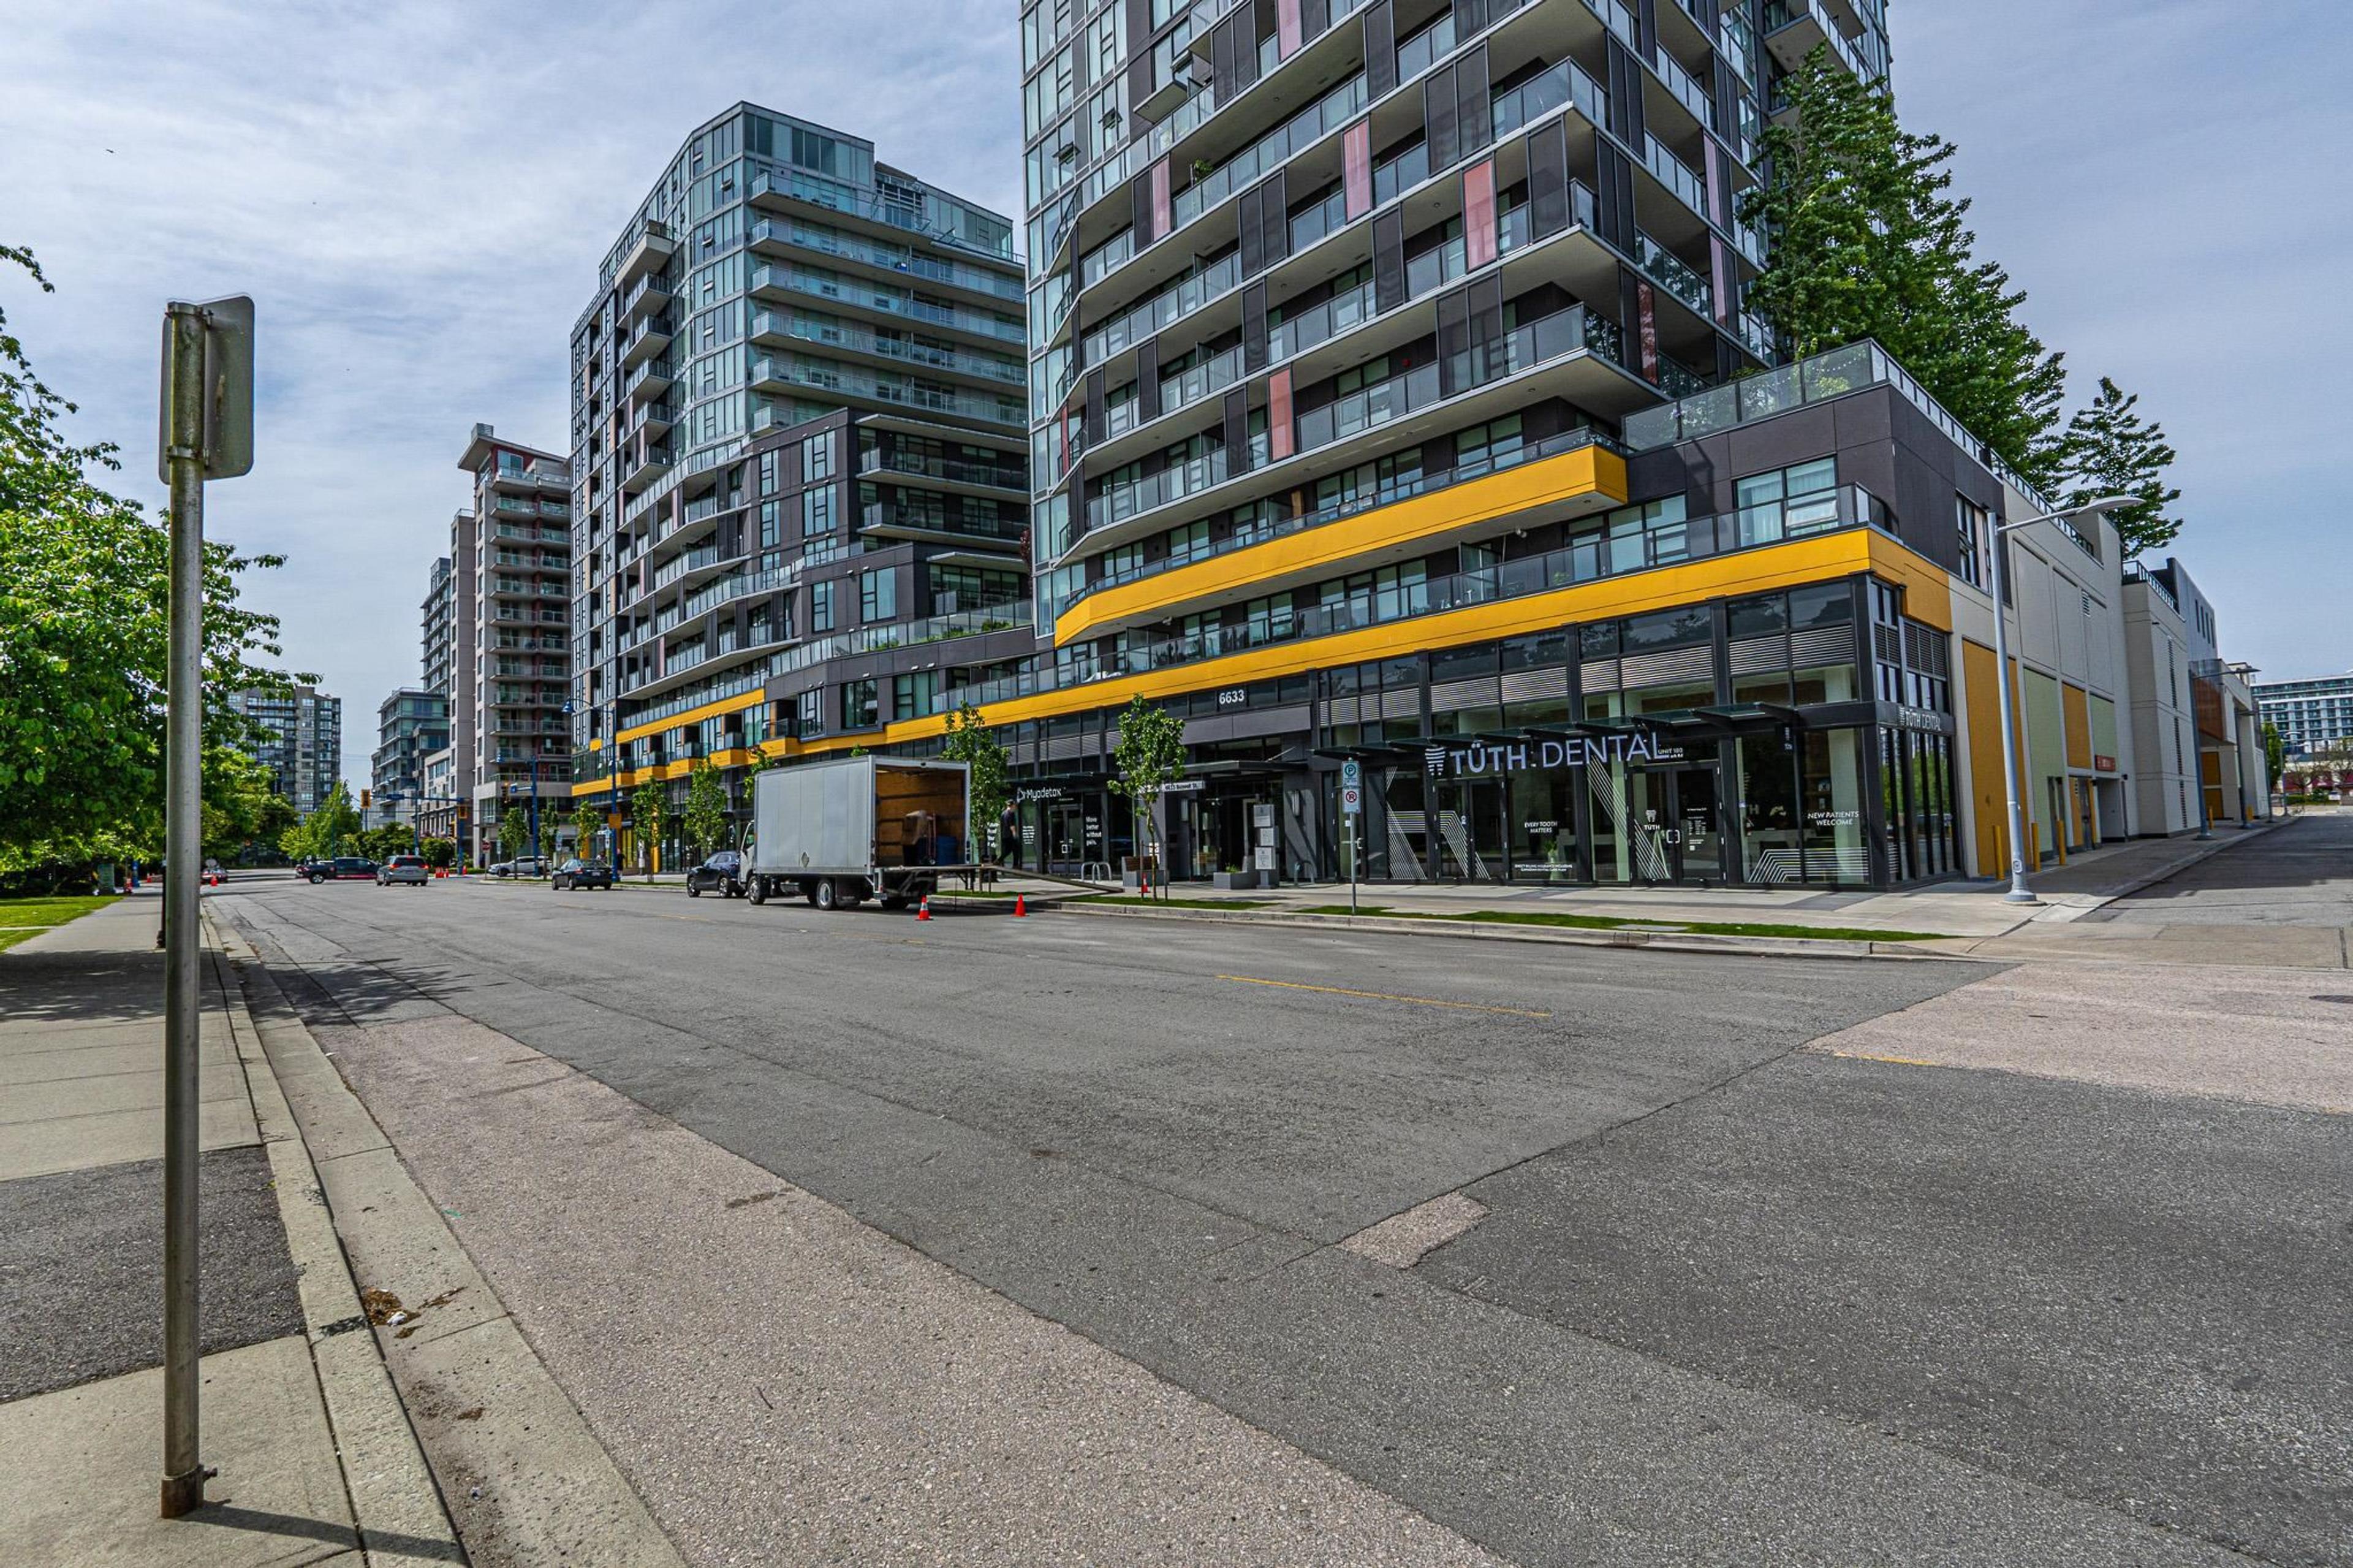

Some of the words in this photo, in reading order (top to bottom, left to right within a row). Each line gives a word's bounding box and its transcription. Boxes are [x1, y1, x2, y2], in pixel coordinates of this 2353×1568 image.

[1219, 689, 1245, 705] 6633
[1922, 713, 1942, 732] DENTAL
[1449, 743, 1527, 775] TÜTH
[1542, 732, 1669, 768] DENTAL
[1026, 786, 1062, 801] Myodetox
